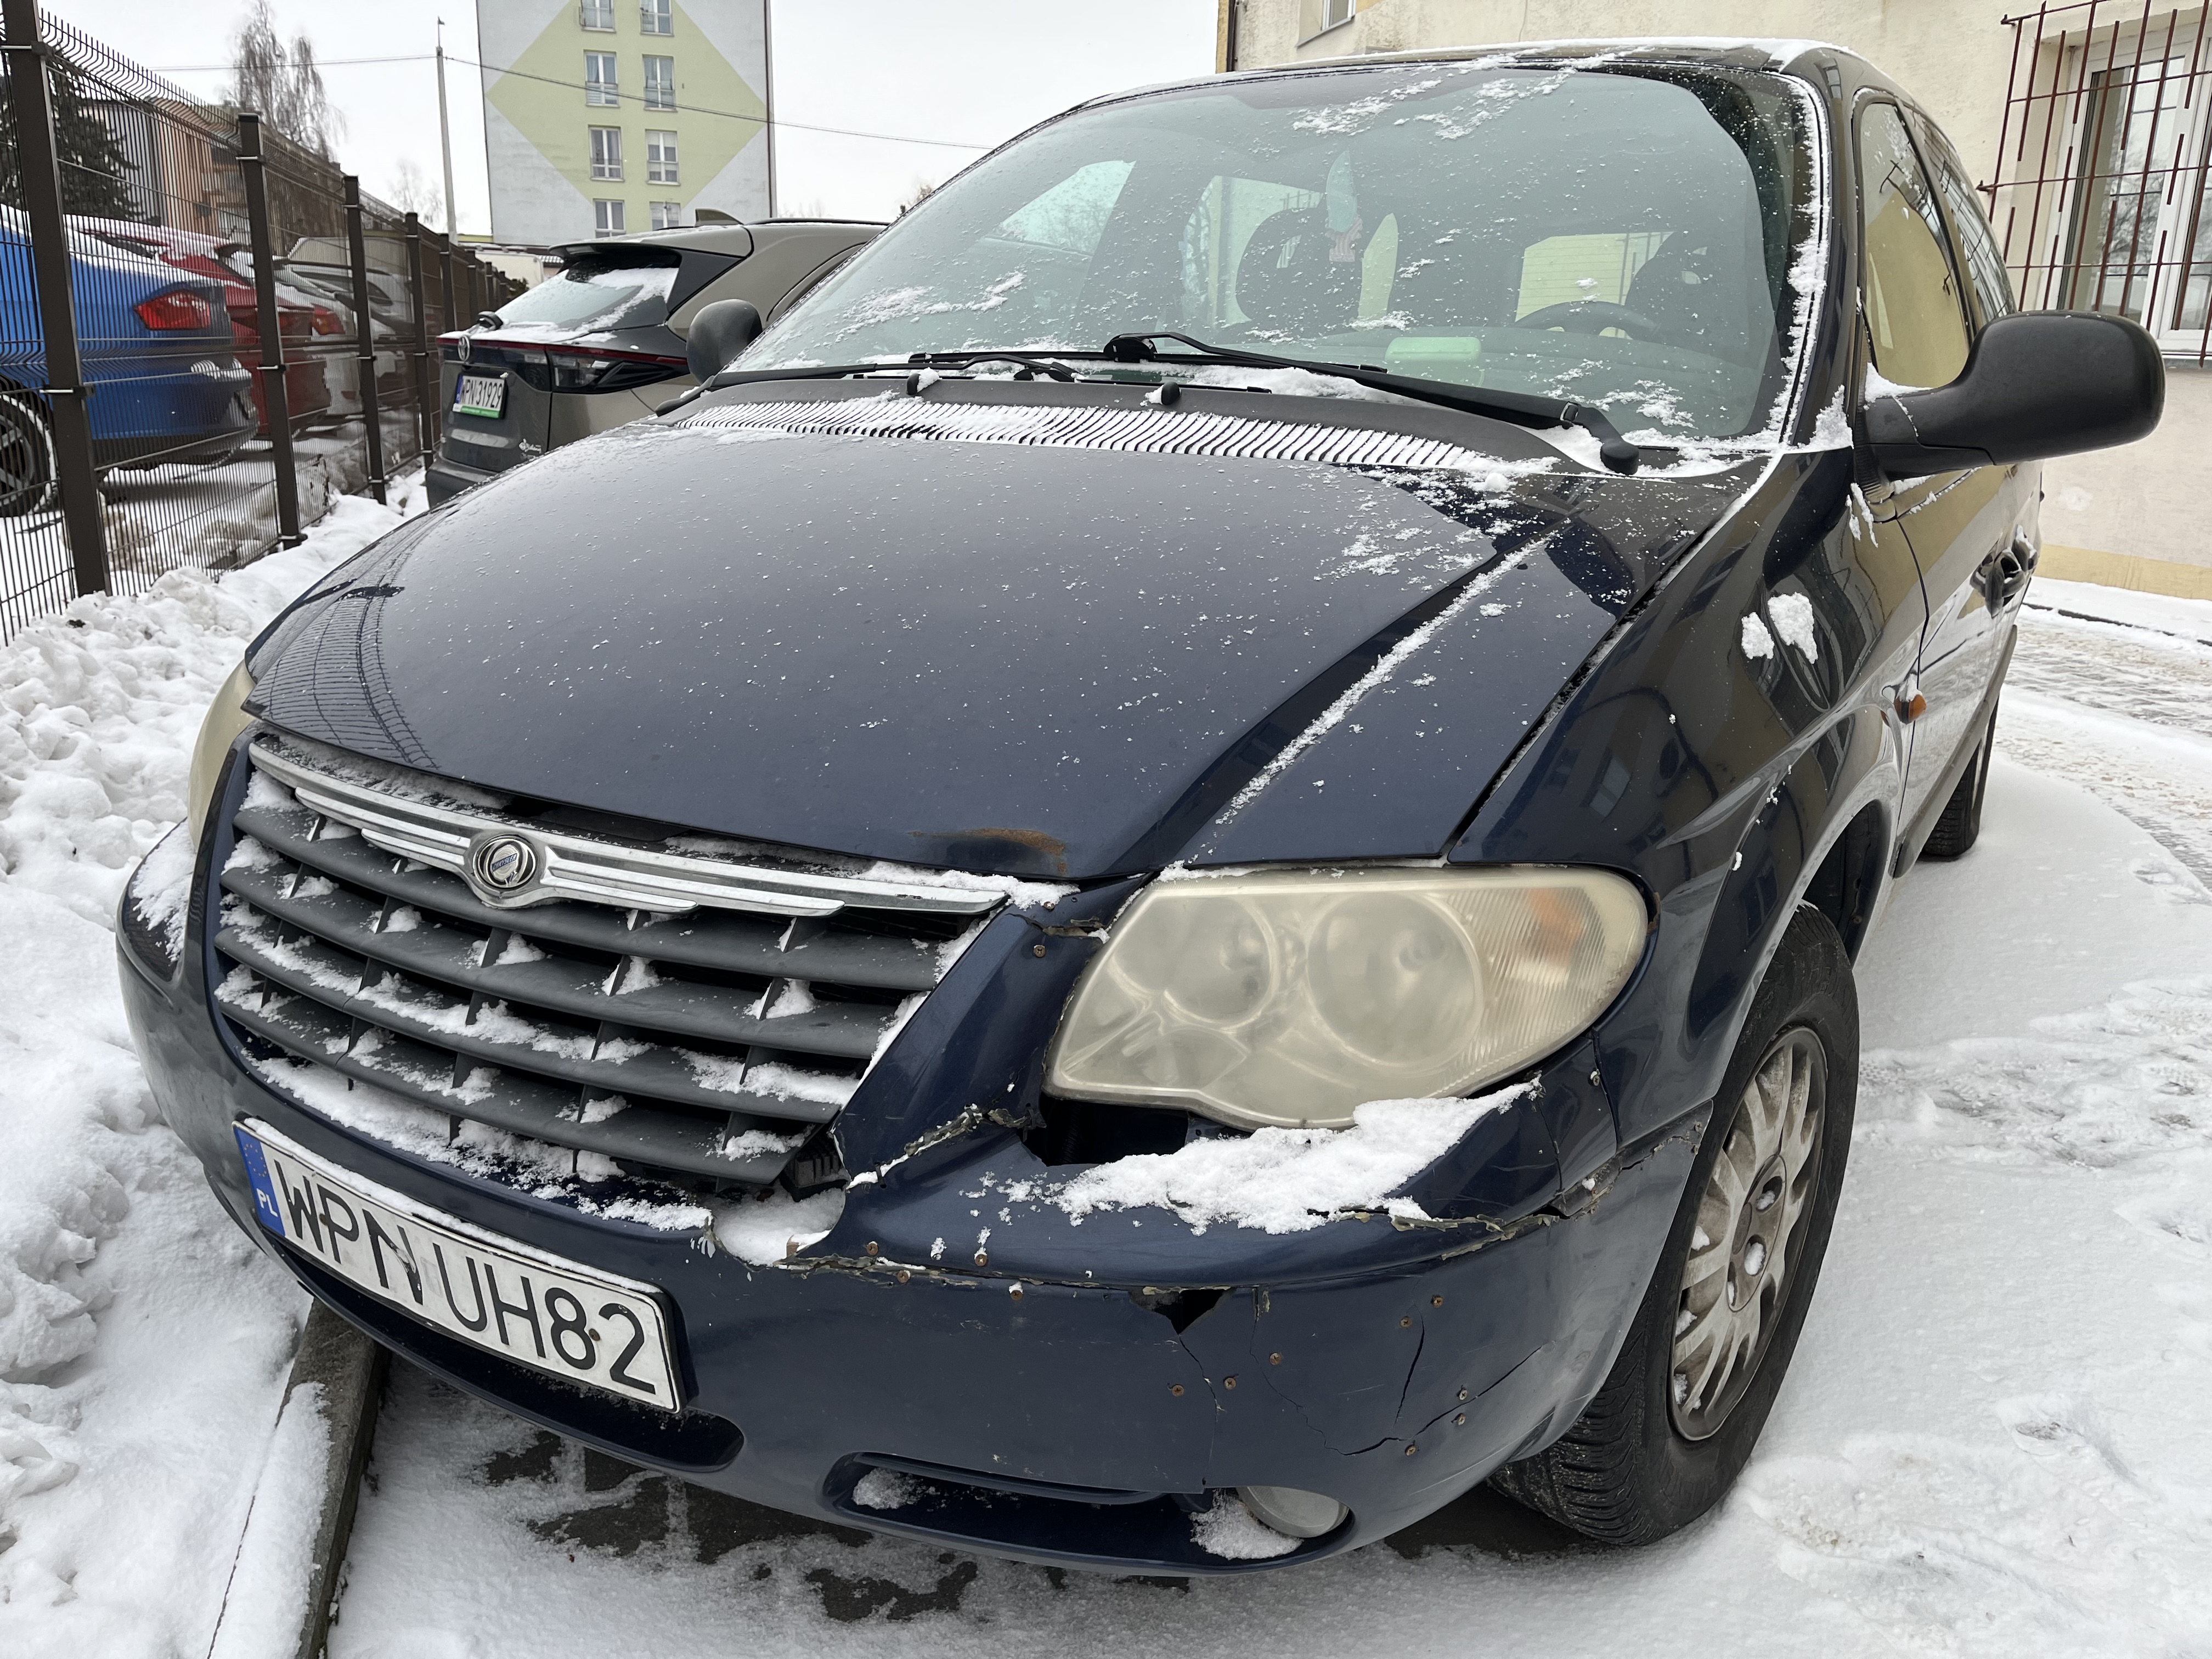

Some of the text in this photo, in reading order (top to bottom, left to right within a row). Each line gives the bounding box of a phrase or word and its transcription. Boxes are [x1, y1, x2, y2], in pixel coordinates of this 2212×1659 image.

[476, 381, 503, 408] 31929
[256, 1188, 278, 1217] PL
[274, 1159, 656, 1395] WPN UH82
